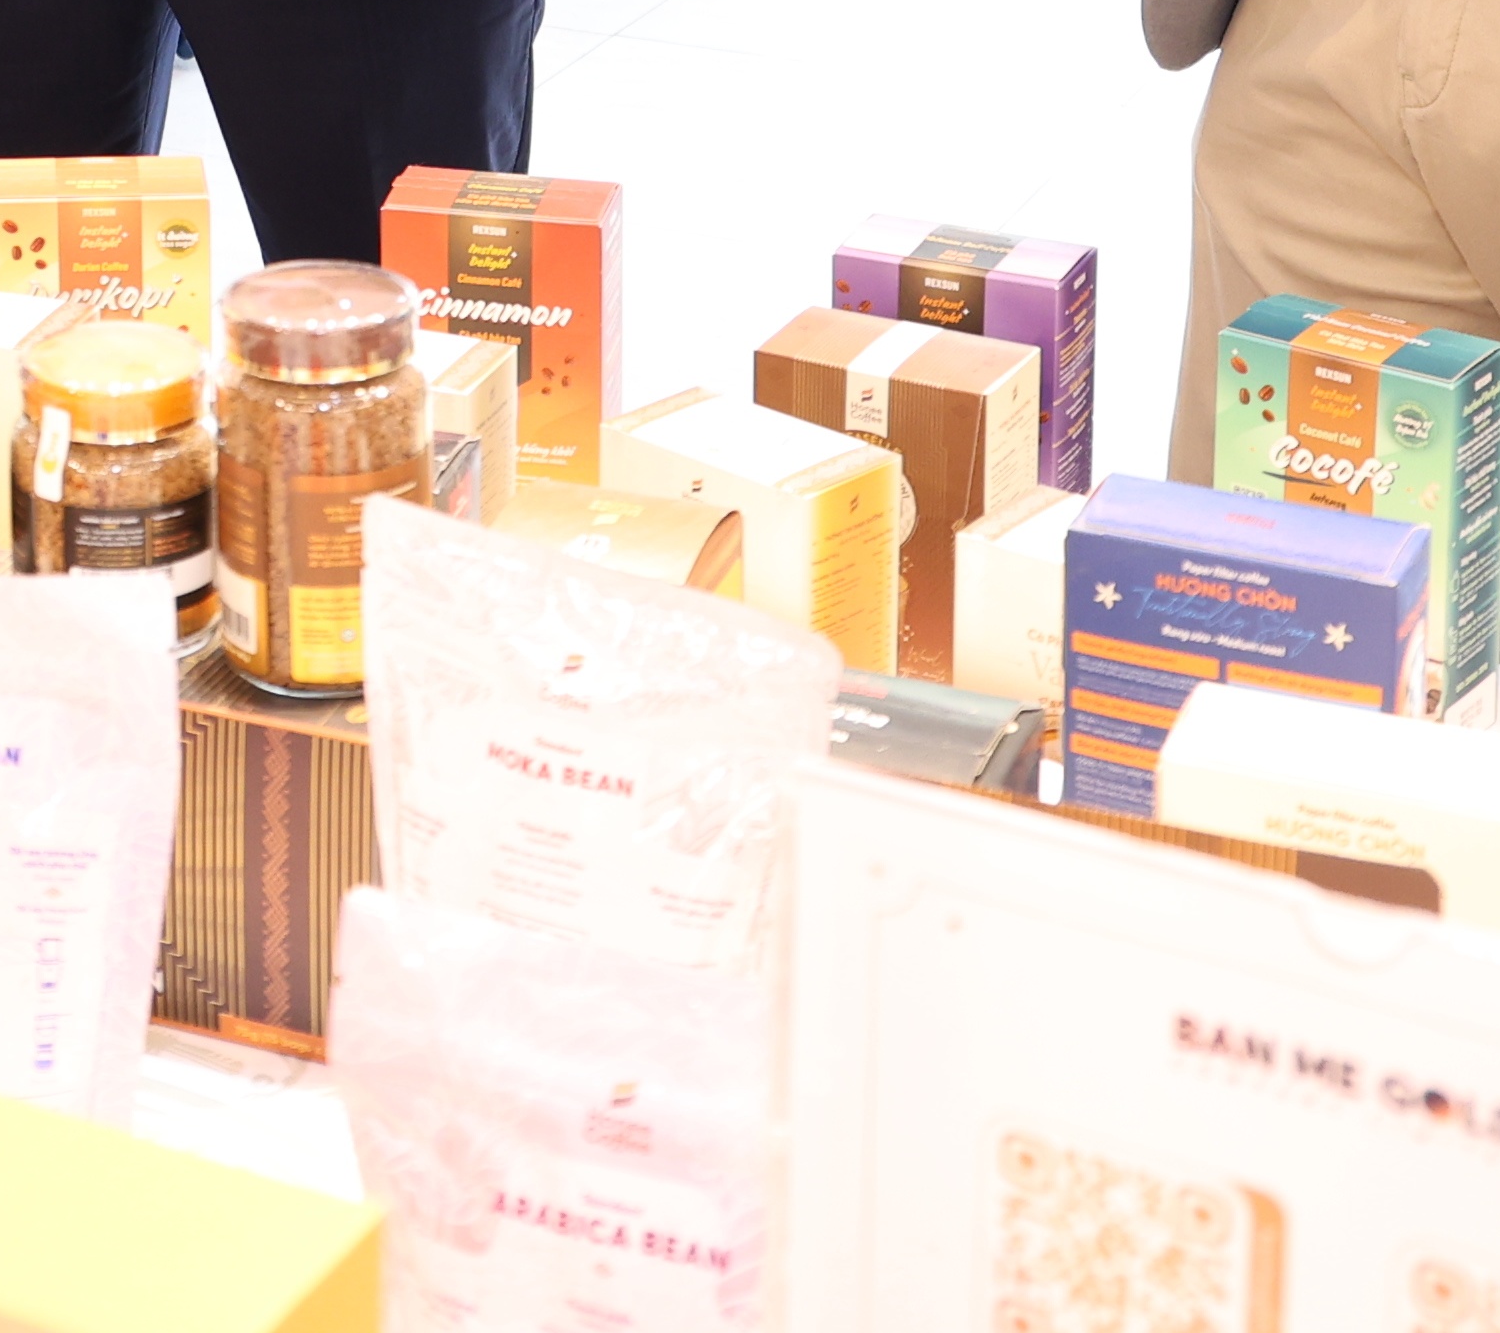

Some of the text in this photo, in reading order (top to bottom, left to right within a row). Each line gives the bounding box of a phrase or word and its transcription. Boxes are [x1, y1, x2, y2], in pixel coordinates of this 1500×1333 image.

[468, 242, 512, 258] Instant
[72, 262, 130, 273] Durian Coffee
[469, 256, 512, 272] Delight
[457, 273, 523, 289] Cinnamon Café
[924, 277, 960, 292] REXSUN
[415, 287, 573, 327] Cinnamon
[919, 294, 964, 311] Instant
[920, 308, 964, 326] Delight
[1315, 366, 1352, 385] REXSUN
[1310, 385, 1357, 403] Instant
[850, 402, 883, 416] Honee
[850, 411, 884, 424] Coffee
[1310, 399, 1357, 419] Delight
[1298, 422, 1362, 449] Coconut Café
[1268, 435, 1400, 495] Cocofé
[1181, 559, 1270, 586] Paper filter coffee
[1155, 572, 1232, 603] HƯƠNG
[486, 739, 635, 799] MOKA BEAN
[1173, 1012, 1276, 1071] BAN
[1293, 1045, 1362, 1099] ME
[490, 1190, 732, 1274] ARABICA BEAN
